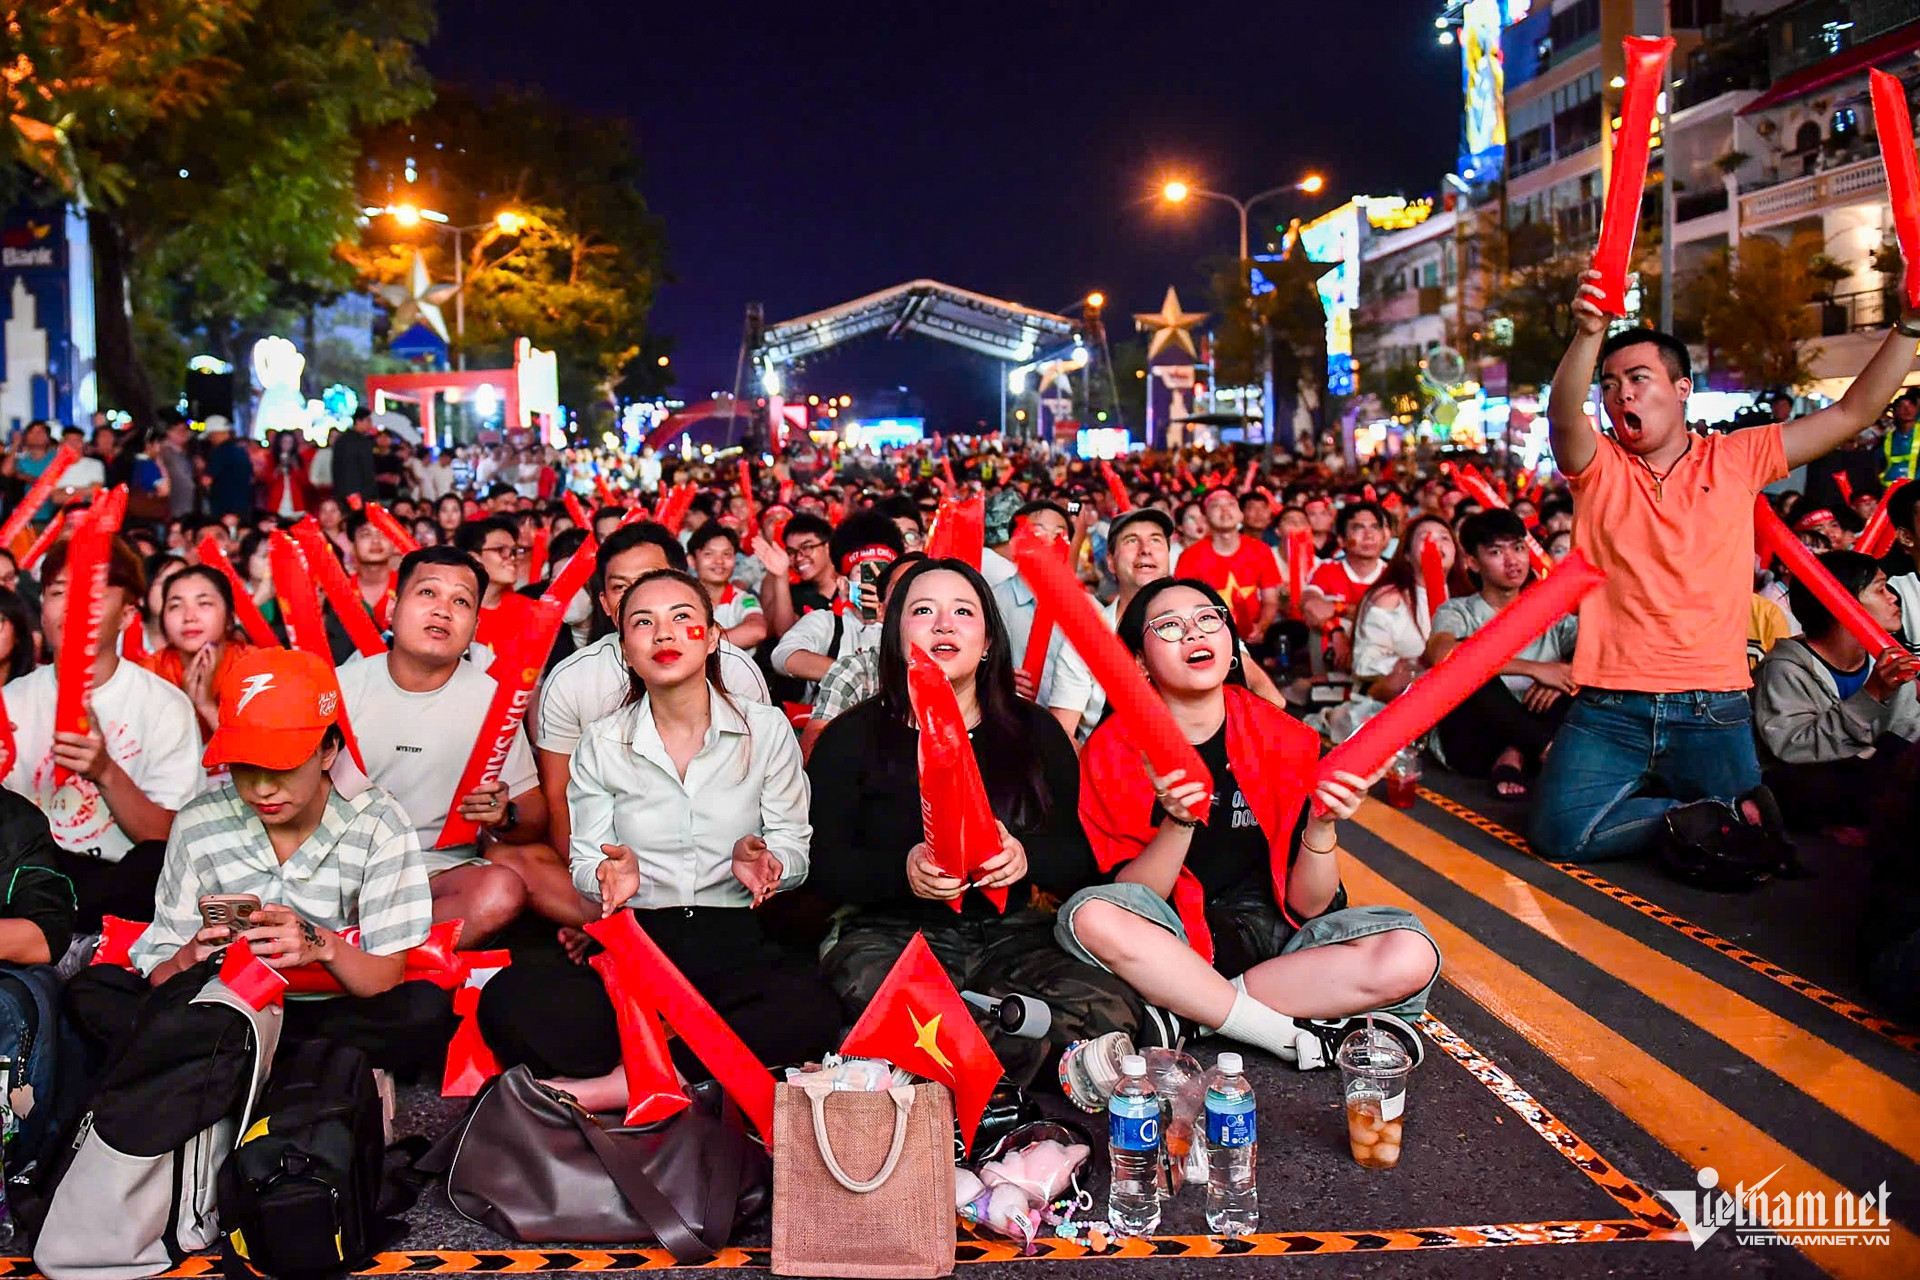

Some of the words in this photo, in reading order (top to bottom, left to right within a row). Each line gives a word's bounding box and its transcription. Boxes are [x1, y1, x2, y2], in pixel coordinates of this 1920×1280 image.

[3, 246, 52, 267] Bank
[500, 689, 533, 732] BIA
[395, 745, 423, 753] MYSTERY
[479, 736, 514, 787] SAIG
